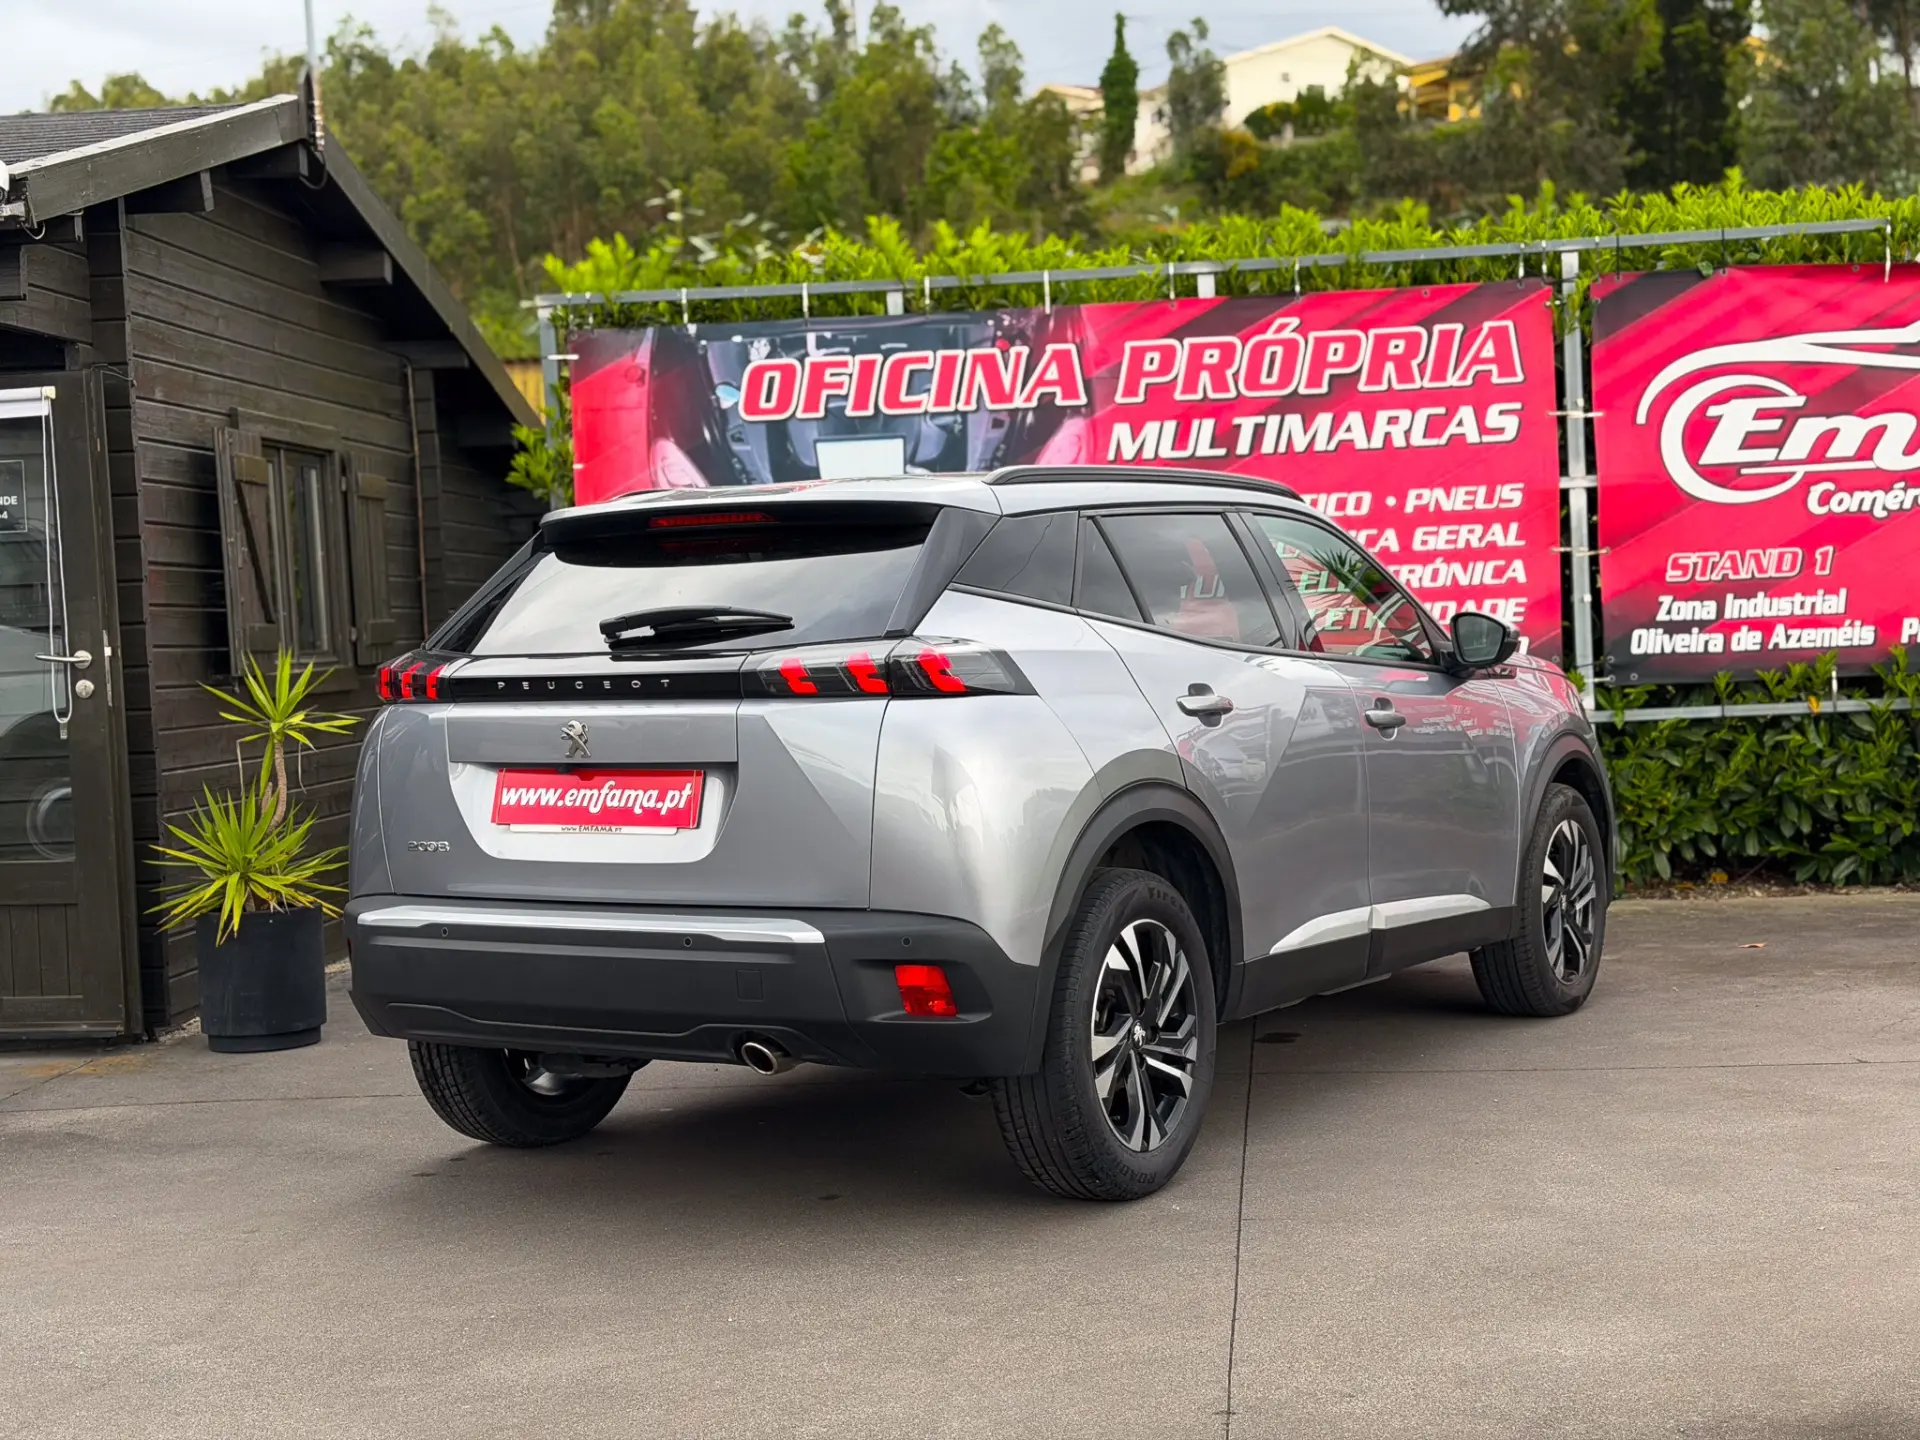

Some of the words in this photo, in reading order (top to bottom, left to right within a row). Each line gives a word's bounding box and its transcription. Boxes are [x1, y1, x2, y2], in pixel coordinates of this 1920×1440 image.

[739, 343, 1087, 421] OFICINA
[1114, 317, 1524, 404] PRÓPRIA
[1107, 403, 1522, 461] MULTIMARCAS
[1403, 483, 1524, 513] PNEUS
[1807, 481, 1920, 518] Comér
[1412, 522, 1526, 551] GERAL
[1665, 548, 1802, 583] STAND
[1815, 546, 1834, 576] 1
[1655, 595, 1718, 621] Zona
[1724, 588, 1848, 619] Industrial
[1630, 627, 1724, 654] Oliveira
[1731, 625, 1762, 652] de
[1768, 619, 1876, 650] Azeméis
[497, 679, 670, 690] PEUGEOT
[501, 780, 693, 815] www.emfama.pt
[407, 840, 450, 851] 2008
